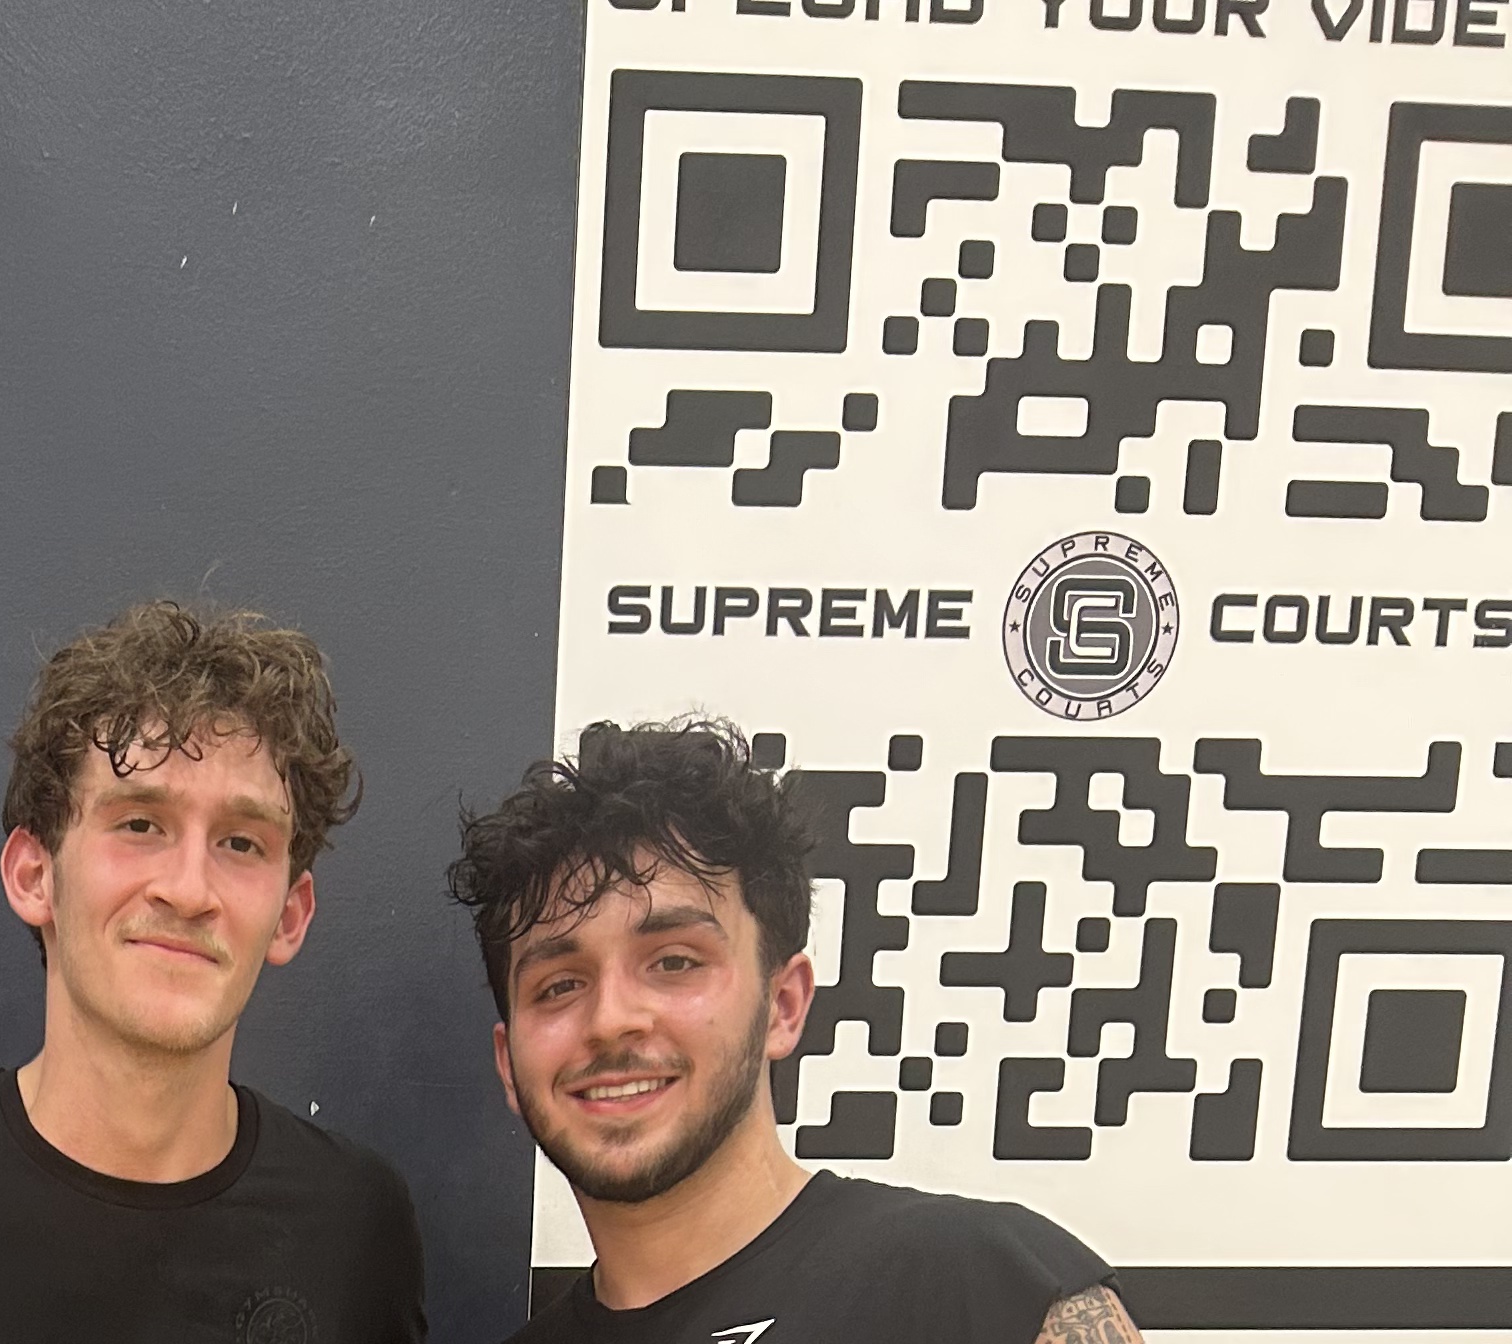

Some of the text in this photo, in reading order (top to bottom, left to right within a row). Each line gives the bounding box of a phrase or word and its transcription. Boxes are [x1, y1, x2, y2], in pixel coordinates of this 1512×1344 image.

[1015, 535, 1175, 611] SUPREME
[608, 585, 974, 639] SUPREME
[1210, 594, 1512, 648] COURTS
[1017, 658, 1164, 719] COURTS
